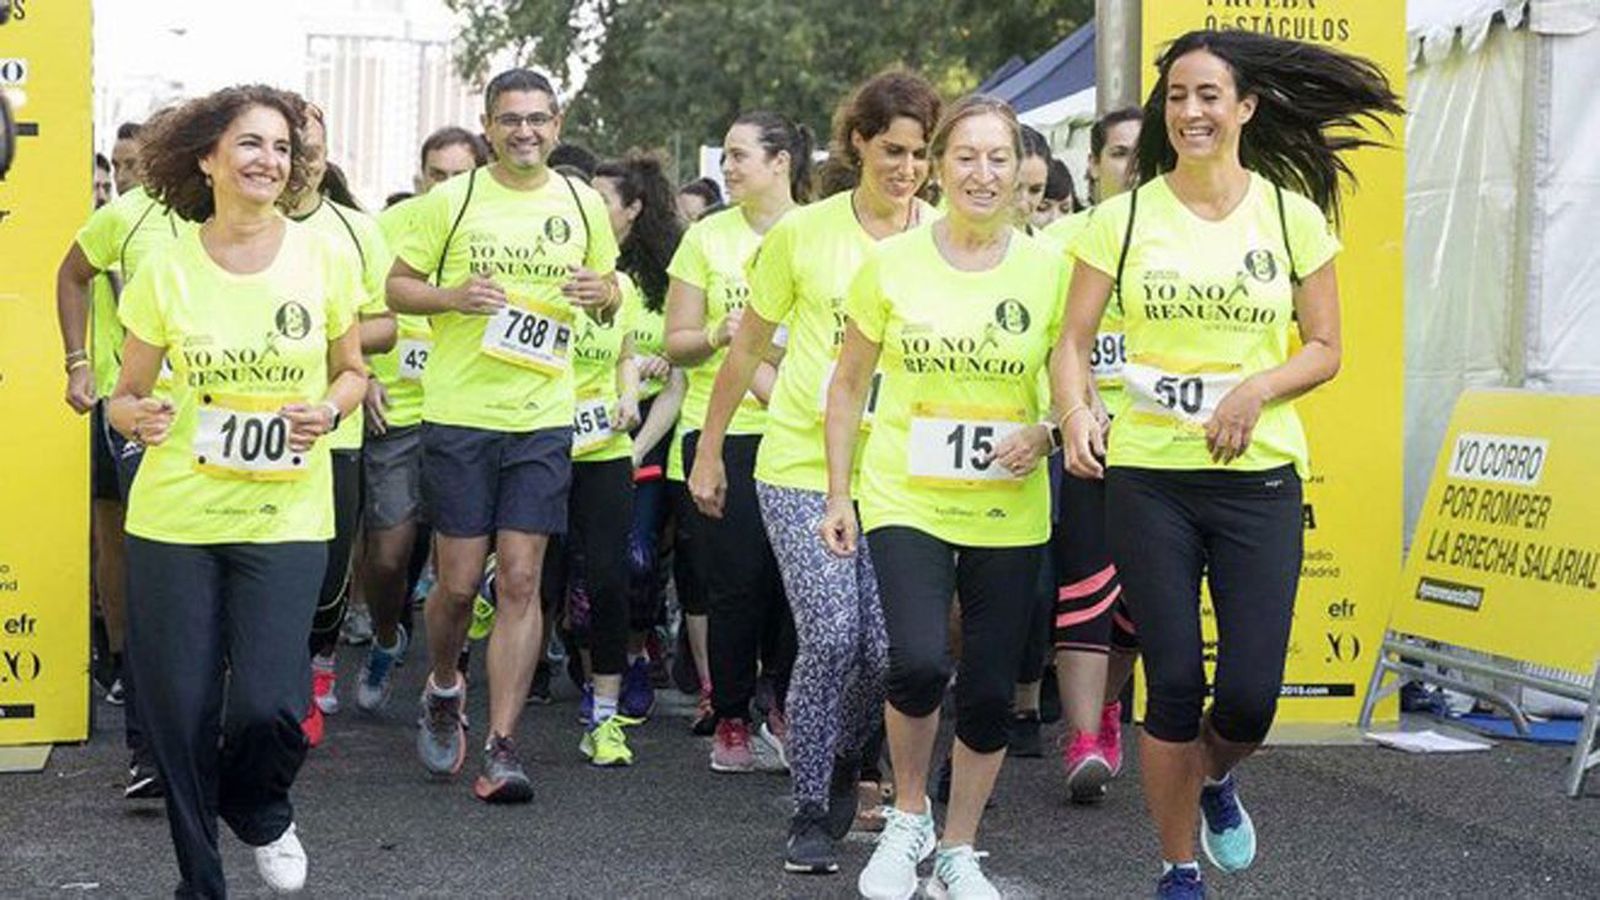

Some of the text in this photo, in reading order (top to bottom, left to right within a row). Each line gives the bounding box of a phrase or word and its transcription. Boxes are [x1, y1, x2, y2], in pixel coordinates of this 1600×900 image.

[1205, 12, 1350, 41] OSTÁCULOS
[470, 245, 530, 260] YO NO
[469, 262, 566, 277] RENUNCIO
[1143, 284, 1225, 301] YO NO
[1144, 303, 1276, 325] RENUNCIO
[504, 309, 549, 348] 788
[901, 337, 975, 354] YO NO
[222, 349, 257, 366] NO
[903, 357, 1025, 375] RENUNCIO
[1155, 376, 1204, 414] 50
[220, 414, 287, 461] 100
[947, 423, 994, 471] 15
[1454, 439, 1543, 480] YO CORRO
[1438, 484, 1553, 530] POR ROMPER
[1426, 529, 1599, 590] LA BRECHA SALARIAL
[1328, 598, 1357, 617] efr
[4, 613, 37, 635] efr
